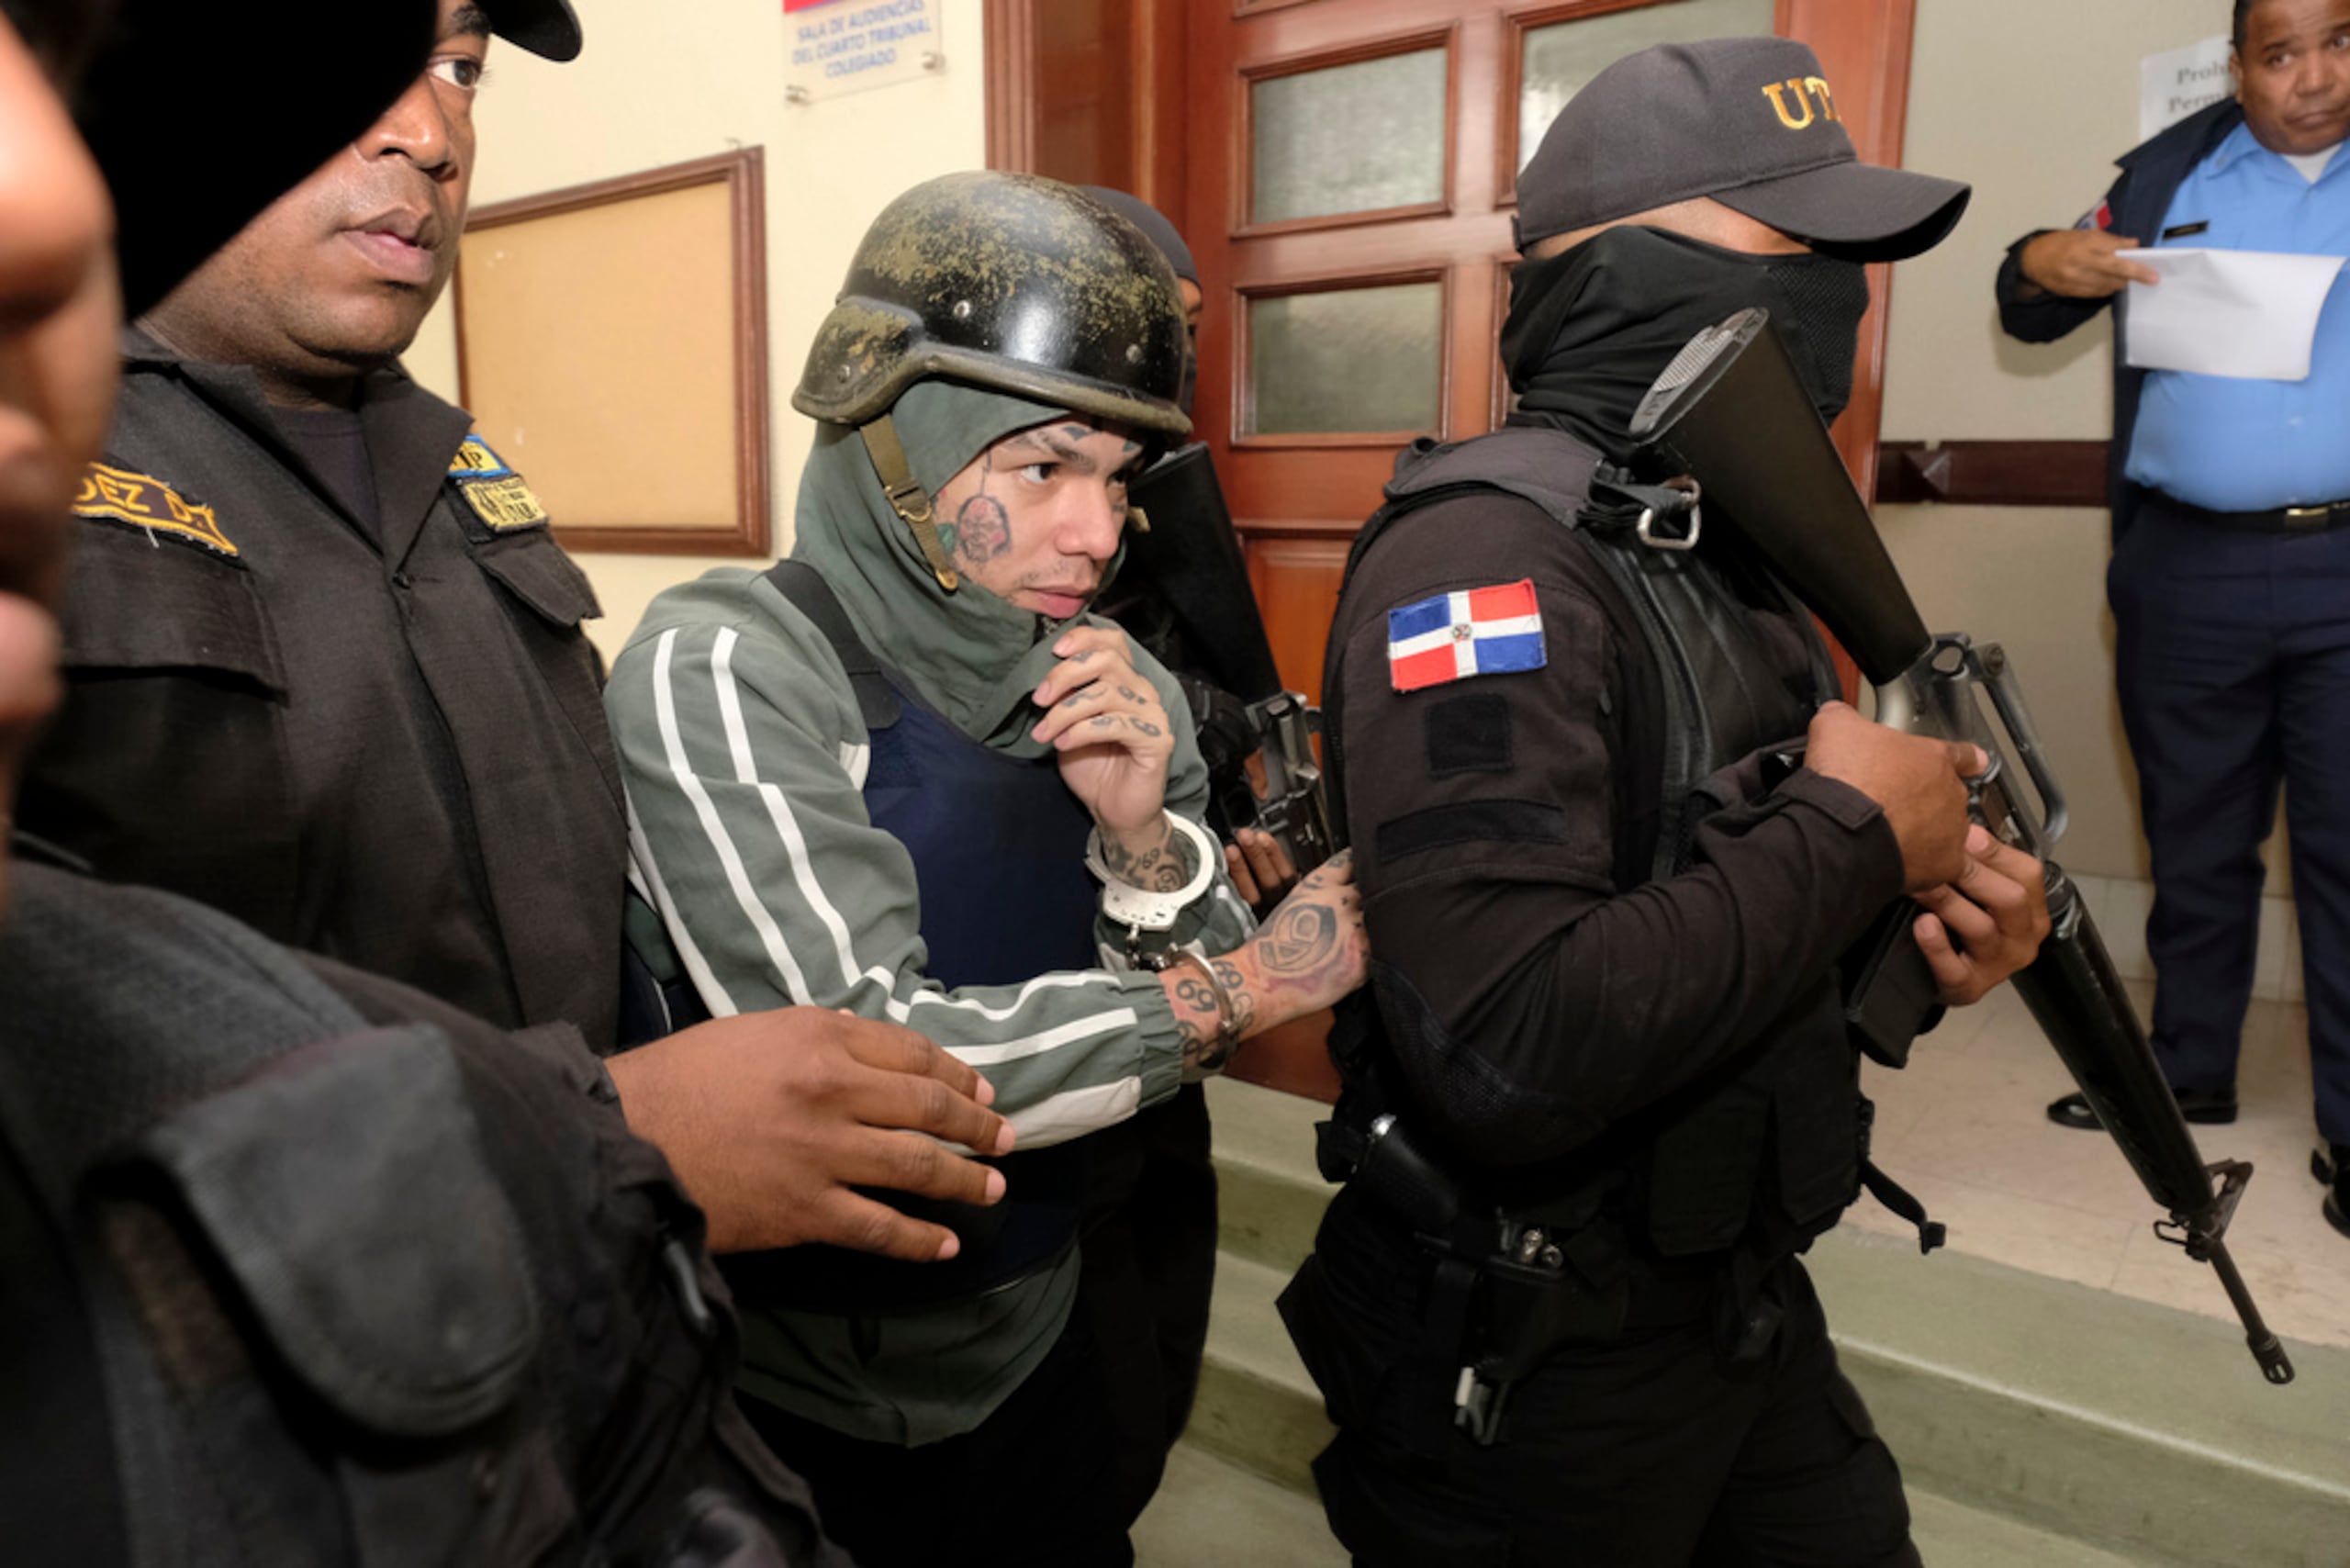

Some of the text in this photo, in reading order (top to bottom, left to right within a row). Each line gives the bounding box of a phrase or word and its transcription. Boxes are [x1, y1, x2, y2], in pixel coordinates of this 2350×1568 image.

[792, 17, 931, 64] DEL CUARTO TRIBUNAL
[798, 0, 924, 41] SALA DE AUDIENCIAS
[824, 48, 897, 78] COLEGIADO
[1762, 76, 1840, 129] UT
[1176, 979, 1217, 1014] 69
